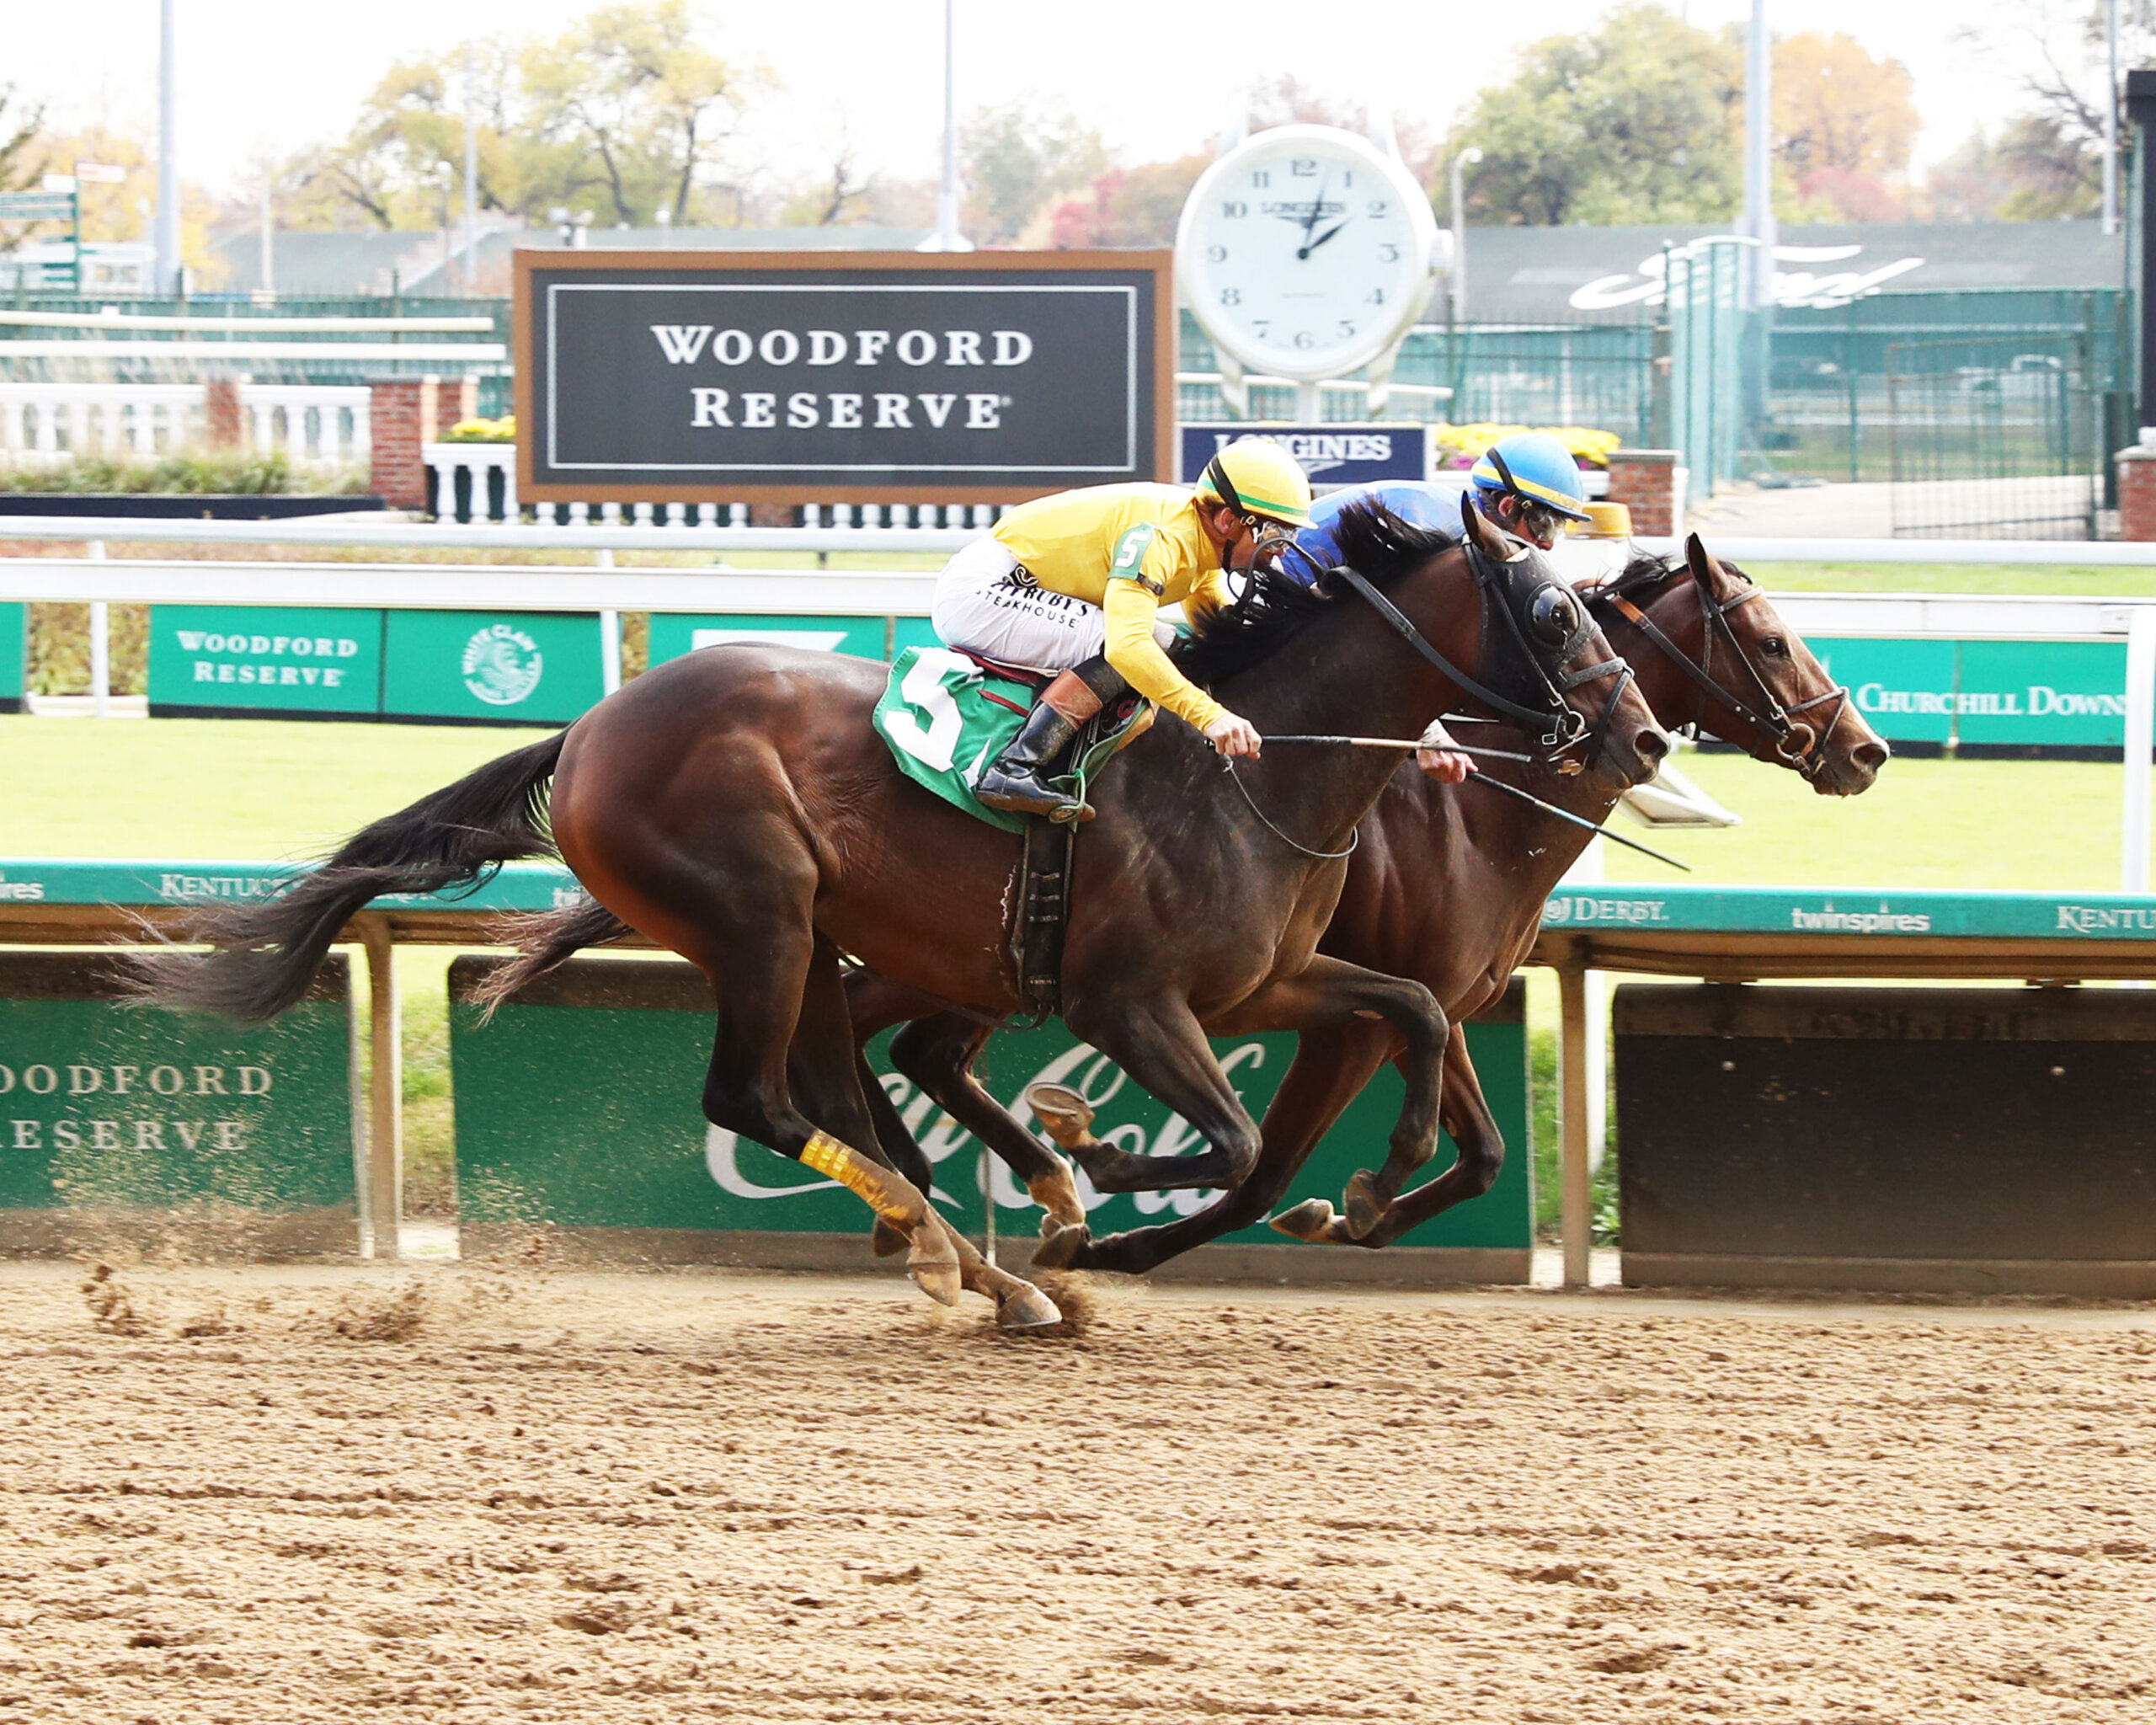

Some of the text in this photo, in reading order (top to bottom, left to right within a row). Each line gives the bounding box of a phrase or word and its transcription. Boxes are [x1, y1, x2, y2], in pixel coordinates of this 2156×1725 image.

[1290, 159, 1316, 177] 12
[1252, 171, 1269, 188] 11
[1344, 170, 1352, 188] 1
[1223, 201, 1248, 219] 10
[1368, 200, 1387, 219] 2
[1208, 245, 1227, 263] 9
[1378, 243, 1399, 263] 3
[1221, 288, 1241, 306] 8
[1365, 288, 1384, 306] 4
[1252, 320, 1271, 339] 7
[1337, 320, 1355, 338] 5
[650, 325, 1033, 366] WOODFORD
[1294, 331, 1314, 350] 6
[1214, 434, 1392, 462] LGINES
[1114, 531, 1148, 569] 5
[176, 630, 359, 657] WOODFORD
[194, 661, 341, 687] RESERVE
[1856, 683, 2024, 715] CHURCHILL
[883, 647, 985, 773] 5
[159, 873, 306, 901] KENTUCK
[1573, 897, 1666, 924] DERBY
[1790, 899, 1931, 933] twinspires
[0, 1119, 248, 1151] ESERVE
